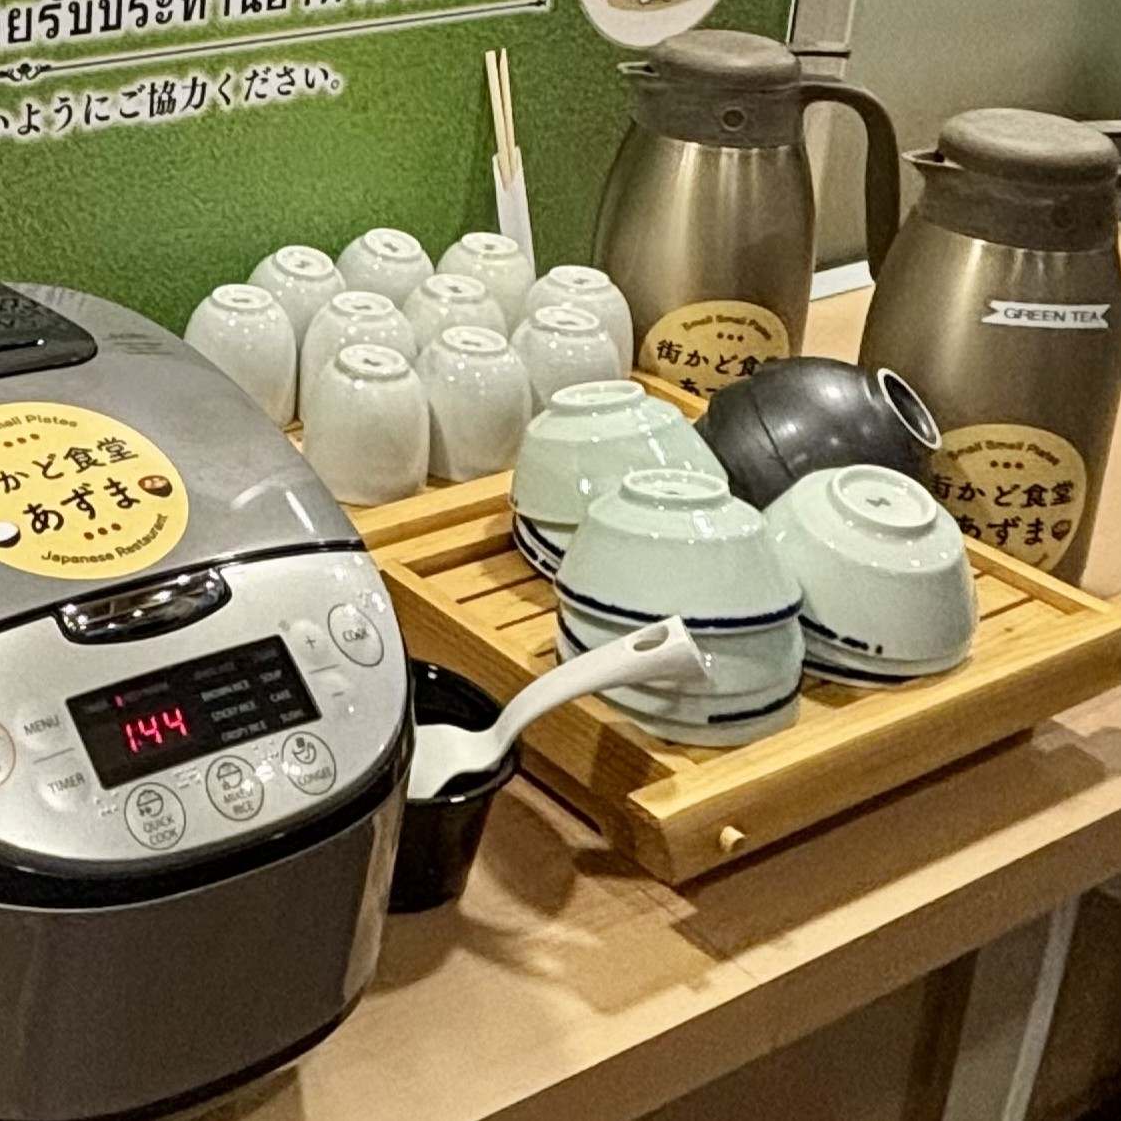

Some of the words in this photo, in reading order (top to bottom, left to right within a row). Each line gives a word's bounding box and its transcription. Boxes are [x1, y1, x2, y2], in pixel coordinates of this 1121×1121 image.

[1004, 307, 1066, 322] GREEN
[1071, 310, 1099, 324] TEA
[656, 339, 777, 377] 街かど食
[23, 477, 141, 534] あずま
[41, 551, 115, 566] Japanese
[117, 513, 169, 558] Restaurant
[23, 714, 61, 735] MENU
[47, 772, 86, 792] TIMER
[143, 815, 174, 833] QUICK
[149, 828, 178, 846] COOK
